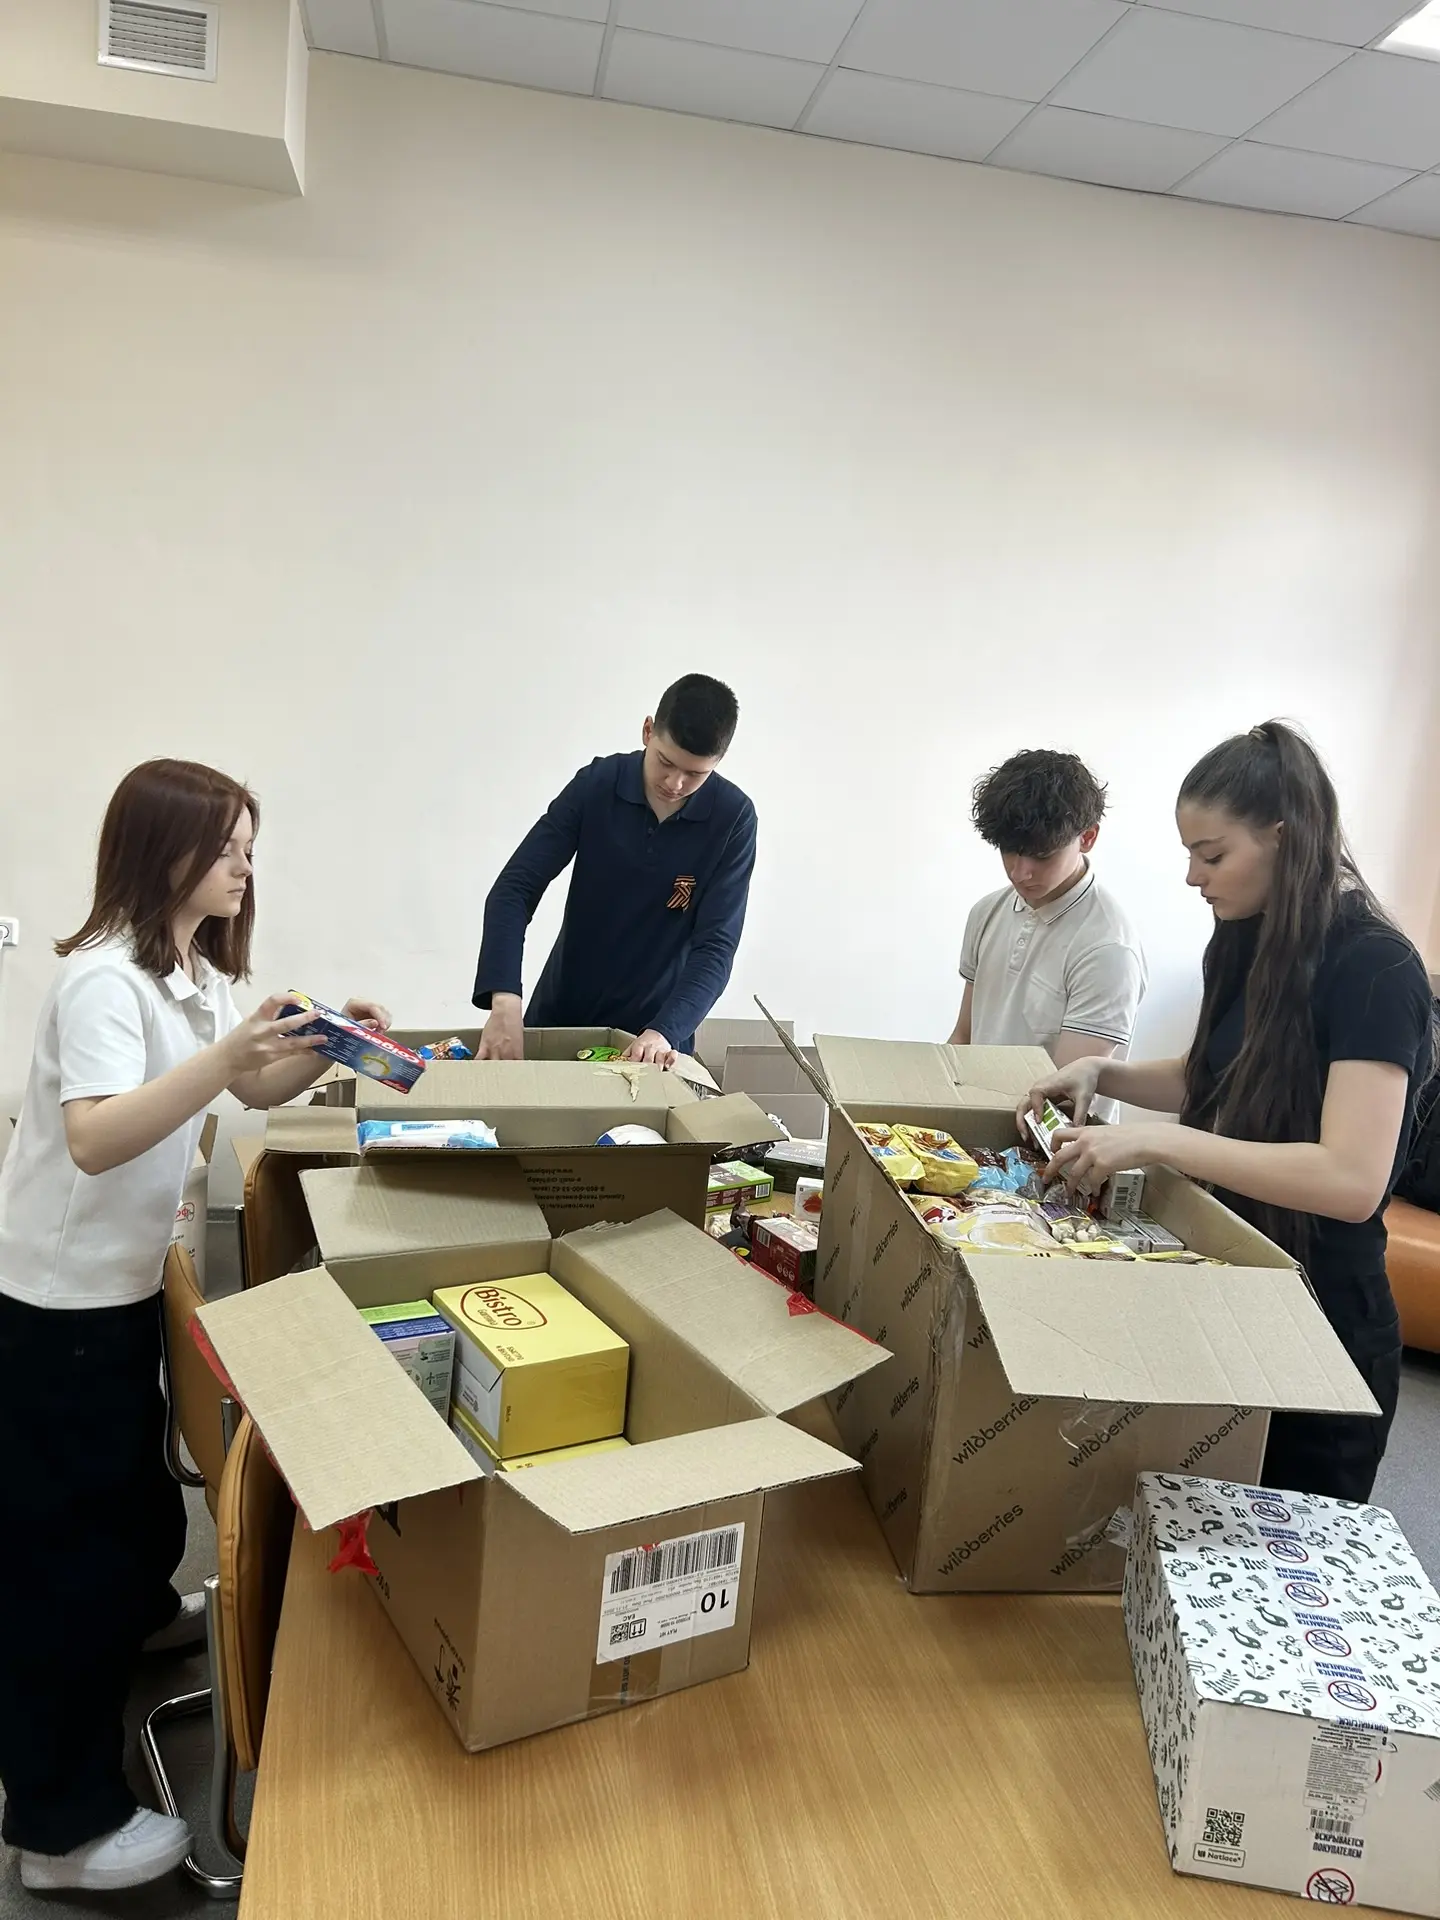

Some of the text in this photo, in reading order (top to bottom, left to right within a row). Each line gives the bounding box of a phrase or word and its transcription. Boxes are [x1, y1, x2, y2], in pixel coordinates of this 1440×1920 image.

[475, 1288, 522, 1326] Bistro
[900, 1262, 932, 1312] wildberries
[1068, 1403, 1150, 1469] wildberrie
[1178, 1406, 1253, 1470] wildberrie
[937, 1503, 1024, 1577] wildberries
[700, 1588, 730, 1613] 10
[1312, 1841, 1363, 1859] ПОКУПАТЕЛЕМ
[1314, 1832, 1365, 1848] ВСКРЫВАЕТСЯ
